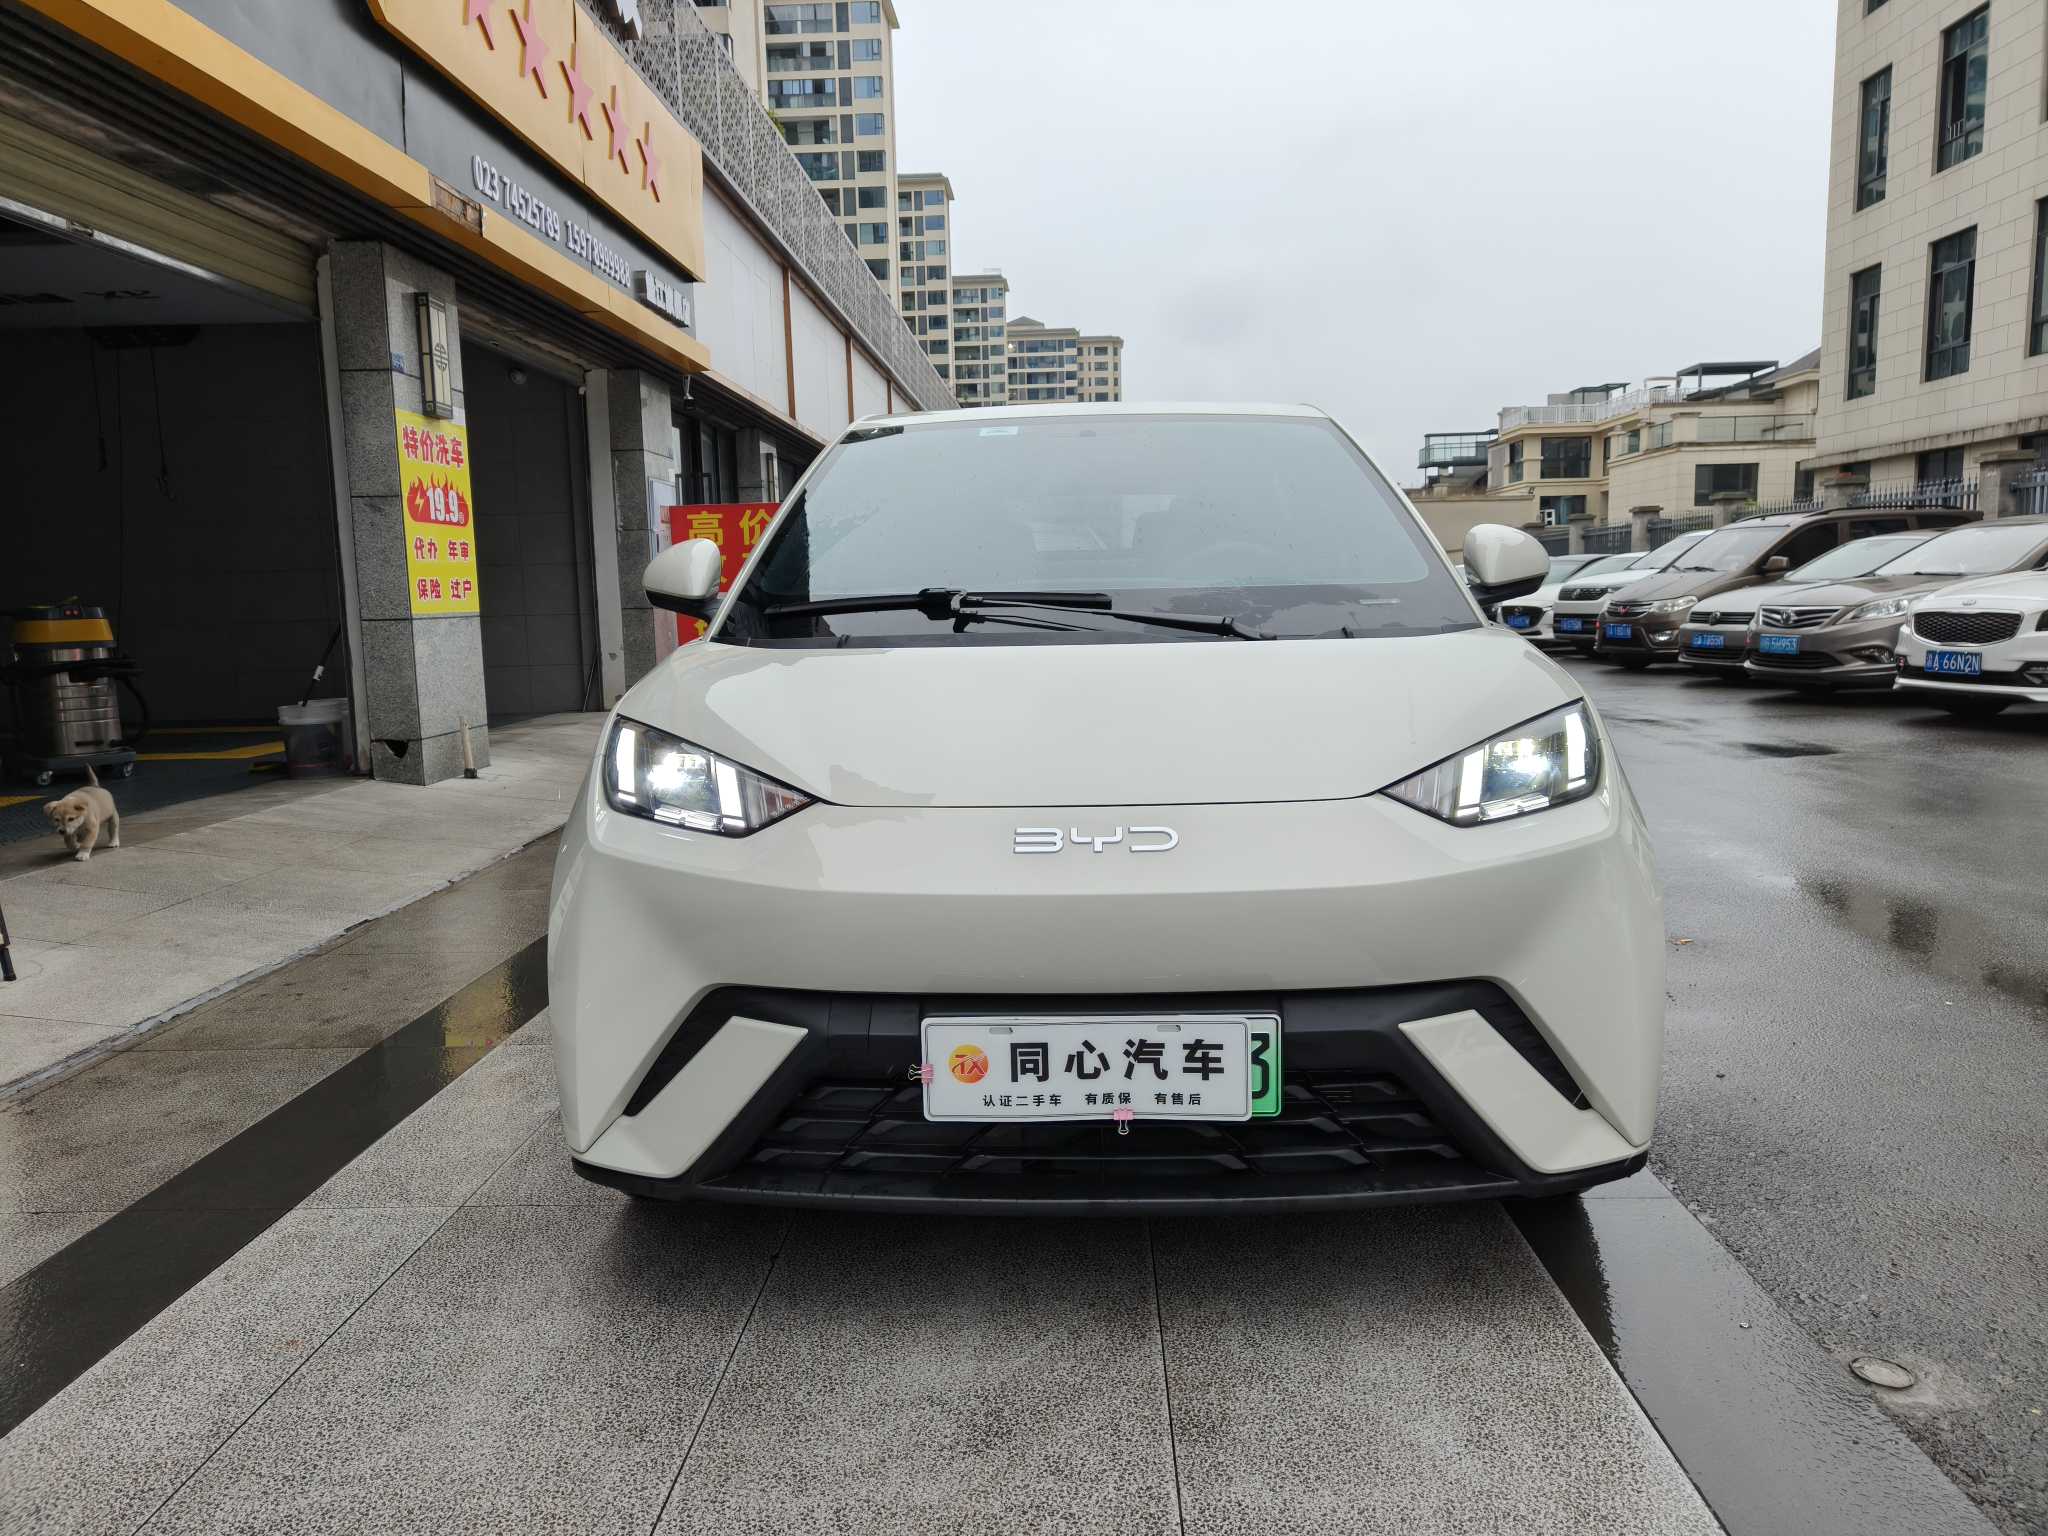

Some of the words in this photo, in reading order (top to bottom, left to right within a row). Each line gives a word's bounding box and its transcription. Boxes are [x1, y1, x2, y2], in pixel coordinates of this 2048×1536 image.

[472, 154, 499, 202] 023
[501, 175, 560, 242] 74525789
[402, 423, 464, 468] 特价洗车
[414, 536, 438, 561] 代办
[448, 539, 470, 561] 年审
[416, 577, 442, 600] 保险
[450, 578, 472, 600] 过户
[1013, 825, 1179, 854] BYD
[1010, 1038, 1225, 1083] 同心汽车
[982, 1093, 1062, 1107] 认证二手车
[1084, 1092, 1133, 1106] 有质保
[1154, 1092, 1202, 1106] 有售后
